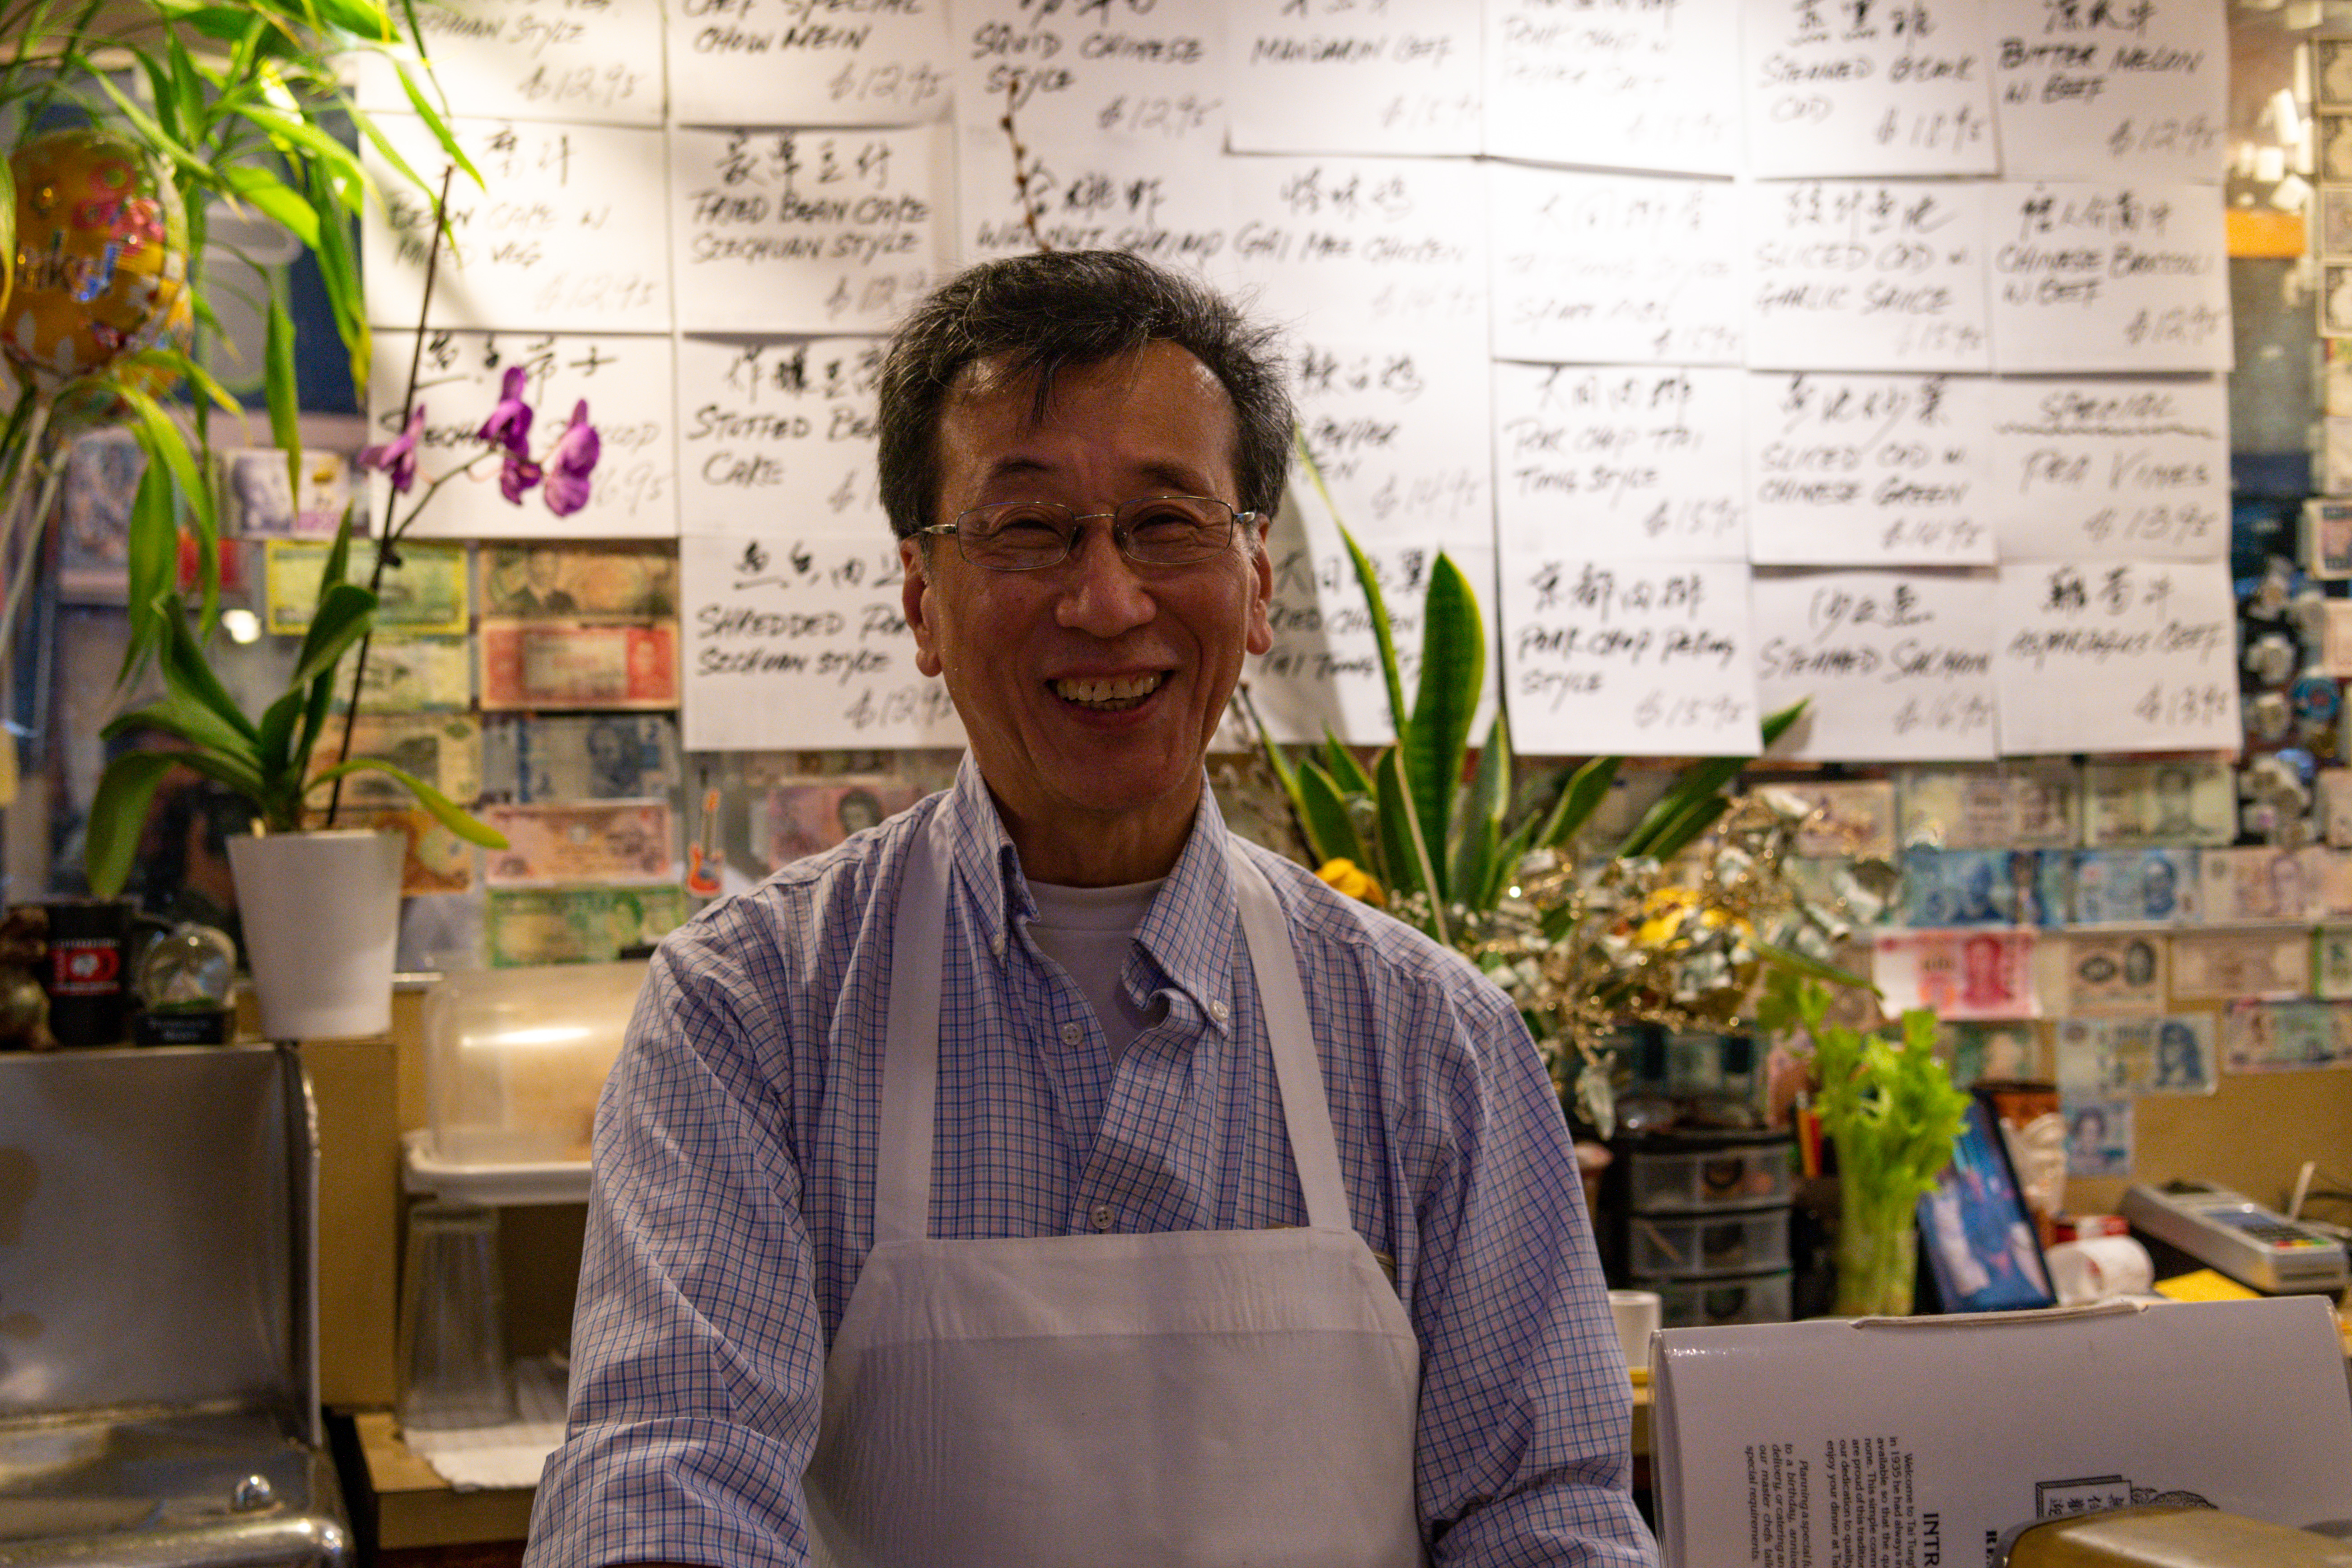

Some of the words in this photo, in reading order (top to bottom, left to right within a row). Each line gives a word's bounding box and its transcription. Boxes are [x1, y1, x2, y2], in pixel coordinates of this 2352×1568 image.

[702, 450, 785, 489] CAKE
[1785, 1444, 1793, 1454] to
[1825, 1440, 1836, 1470] enjoy
[1865, 1438, 1873, 1468] none.
[1889, 1437, 1898, 1446] in
[1745, 1446, 1757, 1484] special
[1772, 1444, 1782, 1491] delivery,
[1851, 1459, 1864, 1490] proud
[1877, 1437, 1888, 1486] available
[1891, 1451, 1901, 1478] 1935
[1762, 1470, 1771, 1508] master
[1799, 1460, 1809, 1510] Planning
[1827, 1474, 1837, 1498] your
[1841, 1460, 1852, 1517] dedication
[1868, 1472, 1876, 1495] This
[1893, 1480, 1901, 1494] he
[1904, 1453, 1914, 1504] Welcome
[1776, 1494, 1783, 1506] or
[1786, 1472, 1797, 1523] birthday,
[1856, 1493, 1865, 1504] of
[1881, 1490, 1888, 1503] so
[1894, 1496, 1902, 1517] had
[1907, 1506, 1914, 1517] to
[1748, 1487, 1760, 1562] requirements.
[1763, 1513, 1773, 1542] chefs
[1775, 1507, 1785, 1552] catering
[1831, 1502, 1839, 1535] dinner
[1844, 1520, 1851, 1531] to
[1856, 1506, 1865, 1525] this
[1868, 1498, 1878, 1534] simple
[1881, 1507, 1889, 1528] that
[1907, 1519, 1916, 1535] Tai
[1800, 1520, 1812, 1558] special
[1832, 1539, 1839, 1549] at
[1893, 1520, 1903, 1557] always
